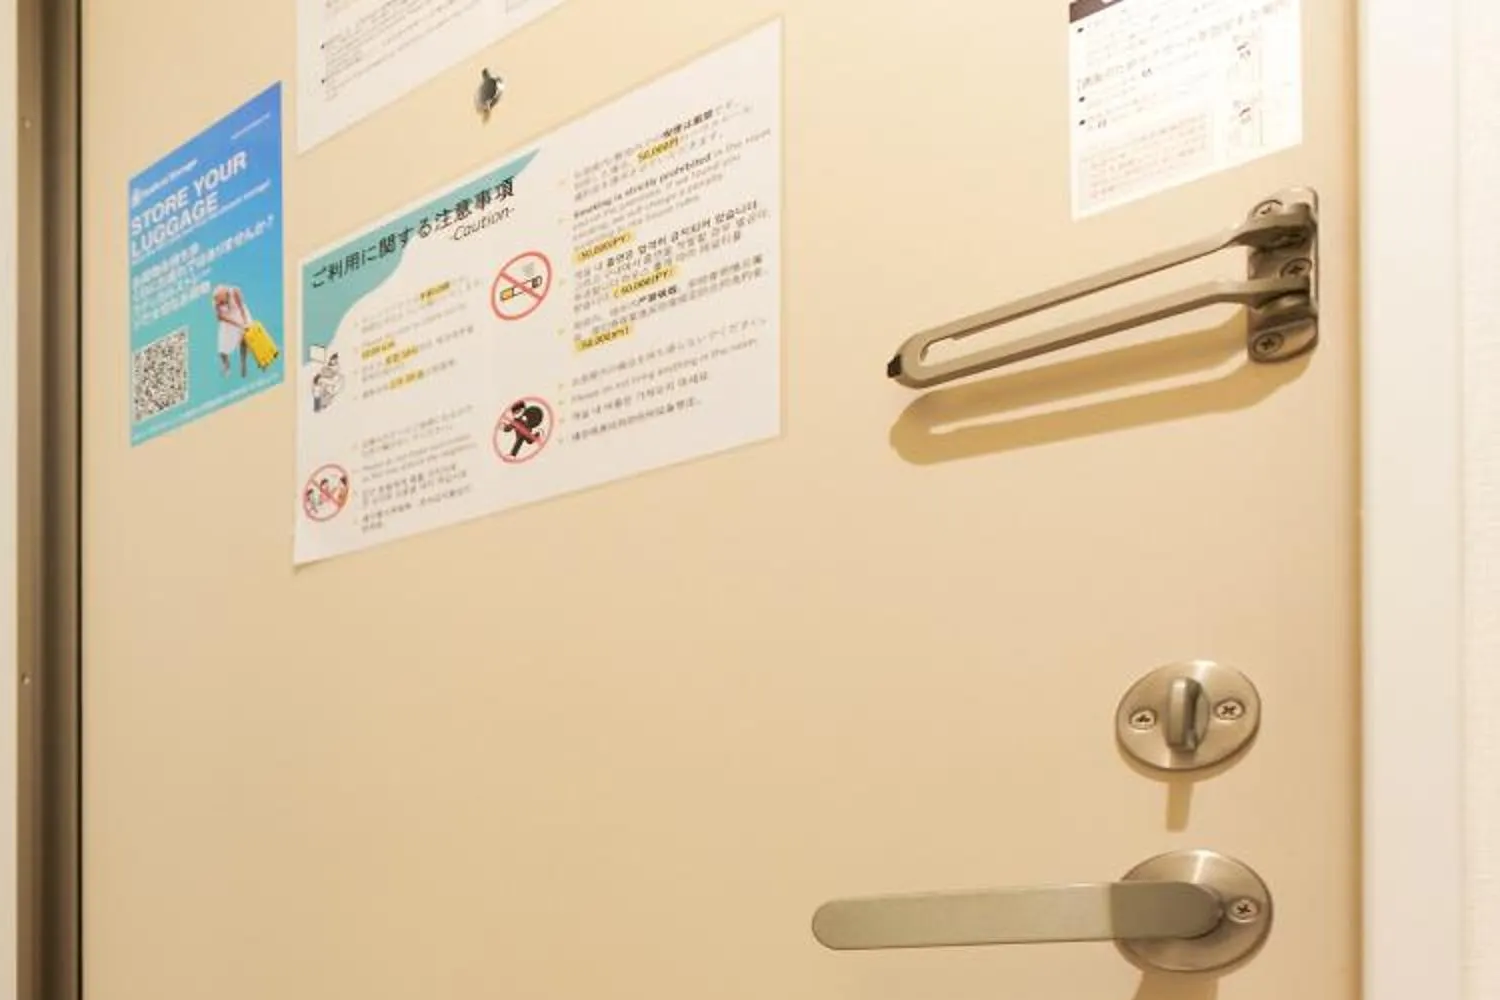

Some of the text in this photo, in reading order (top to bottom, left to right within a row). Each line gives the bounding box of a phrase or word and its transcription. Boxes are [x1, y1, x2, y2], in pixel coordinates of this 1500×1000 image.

[131, 186, 190, 236] STORE
[193, 150, 248, 197] YOUR
[660, 153, 710, 181] prohibited
[131, 191, 219, 259] LUGGAGE
[312, 176, 515, 288] ご利用に関する注意事項
